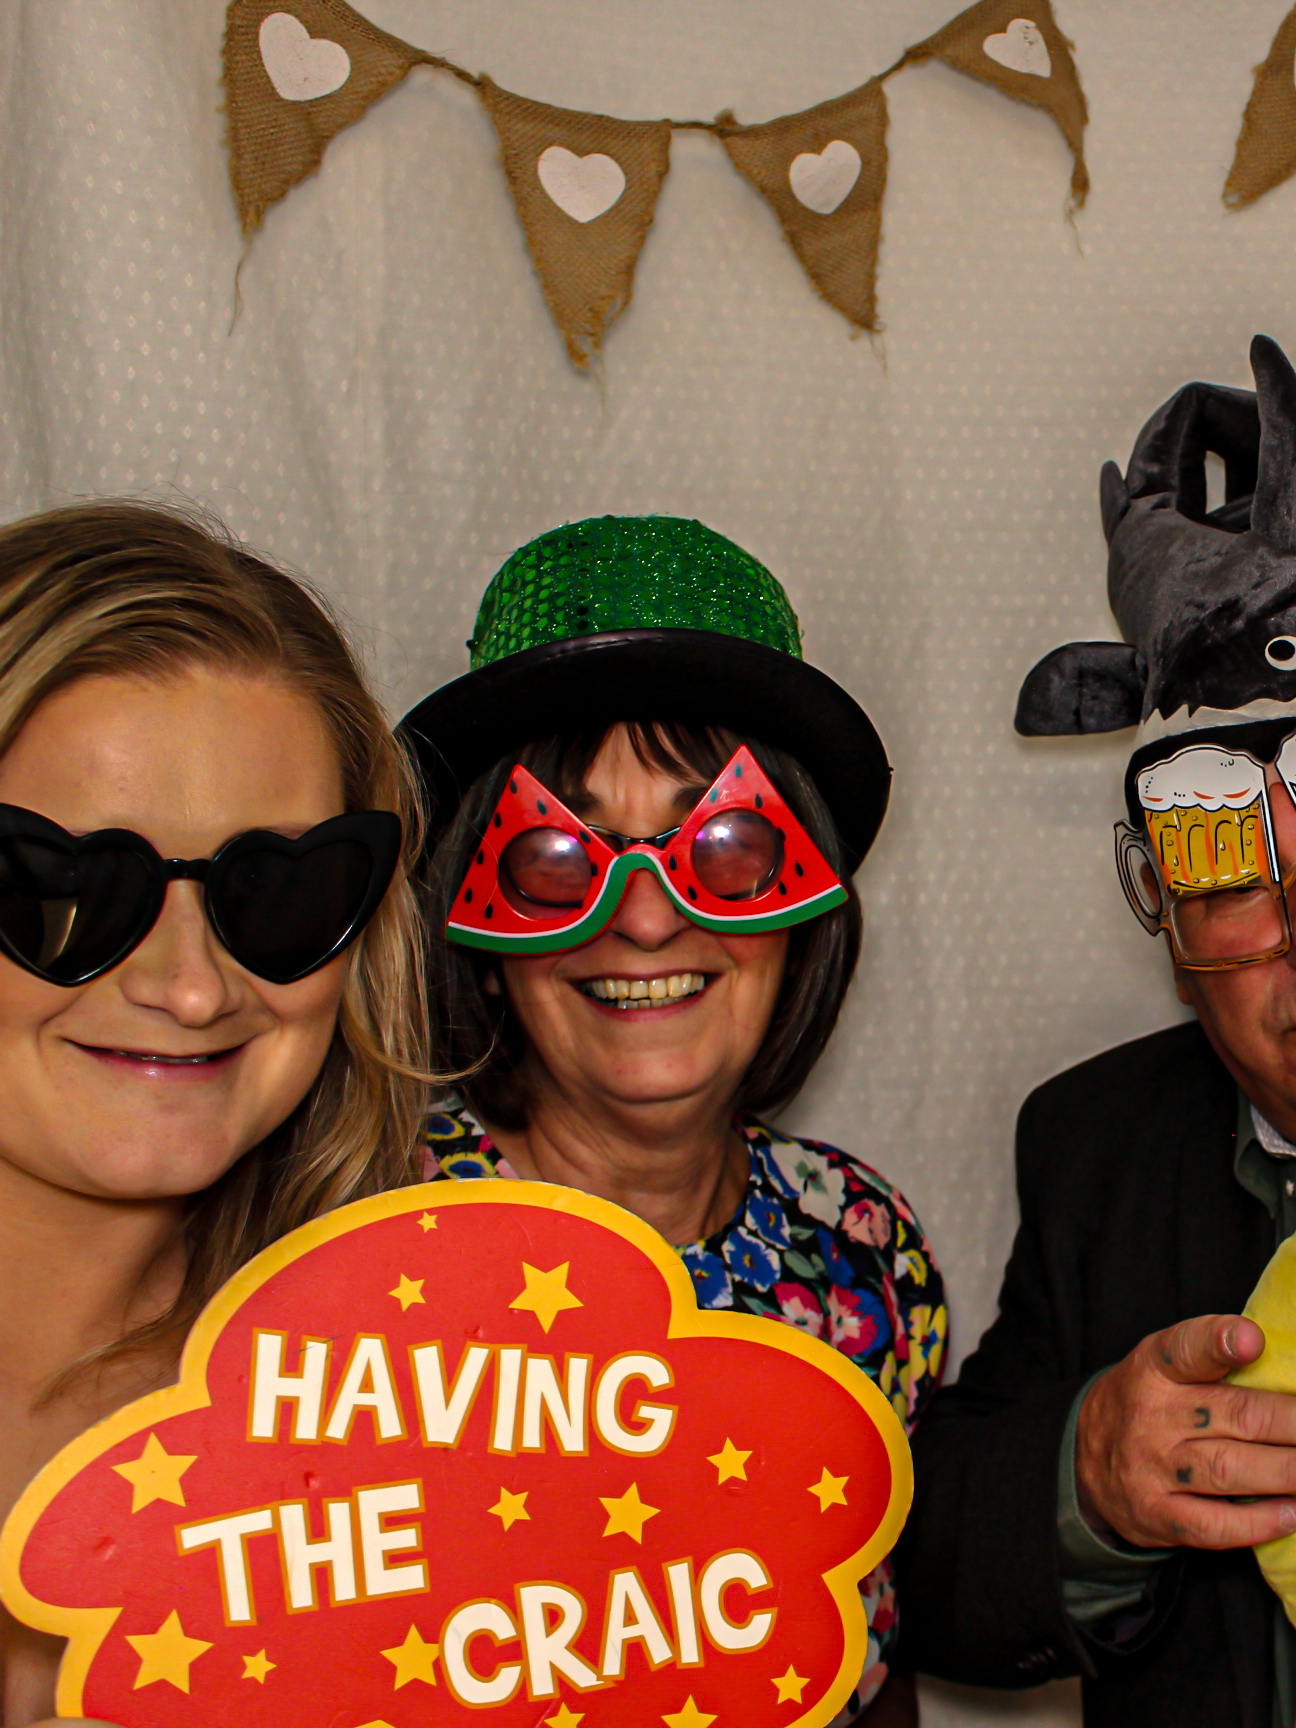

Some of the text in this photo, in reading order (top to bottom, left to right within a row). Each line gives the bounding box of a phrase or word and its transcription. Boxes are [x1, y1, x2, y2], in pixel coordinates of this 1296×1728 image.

[251, 1332, 674, 1453] HAVING
[180, 1482, 426, 1622] THE
[443, 1551, 773, 1705] CRAIC
